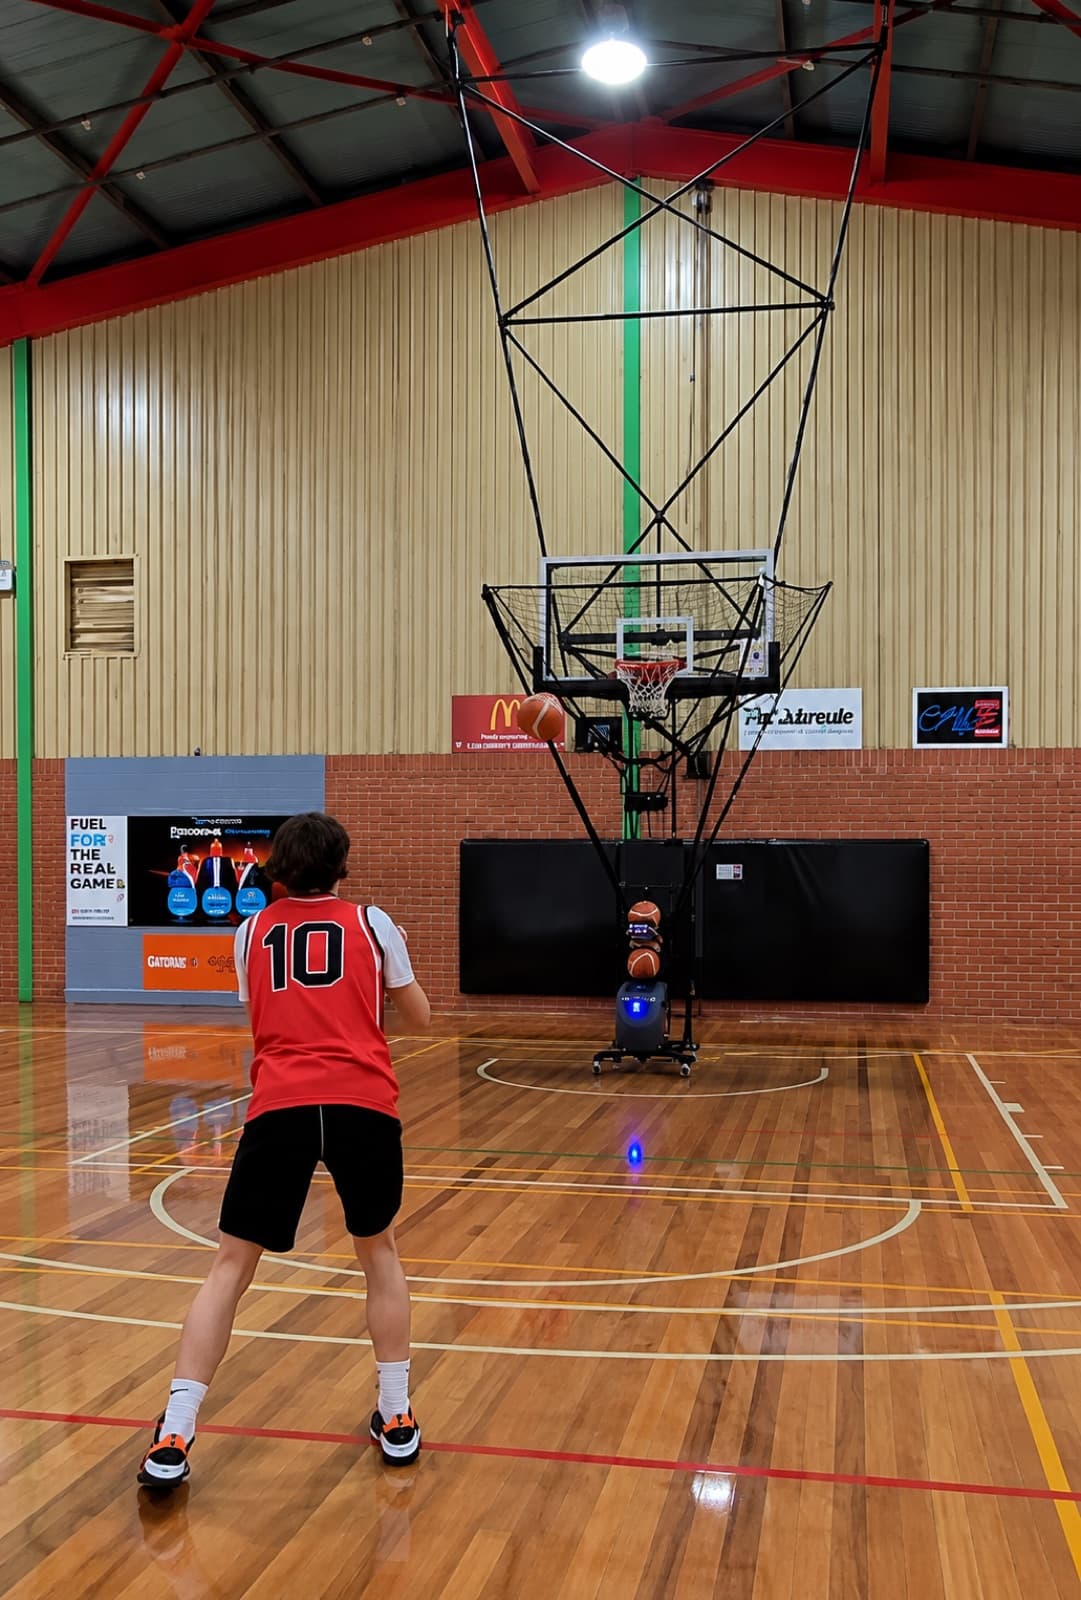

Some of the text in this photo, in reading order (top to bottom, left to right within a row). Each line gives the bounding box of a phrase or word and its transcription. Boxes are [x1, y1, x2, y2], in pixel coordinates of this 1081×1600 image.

[70, 818, 107, 830] FUEL
[70, 833, 106, 847] FOR
[70, 849, 101, 860] THE
[70, 863, 116, 875] REAL
[70, 878, 114, 889] GAME
[262, 921, 344, 992] 10
